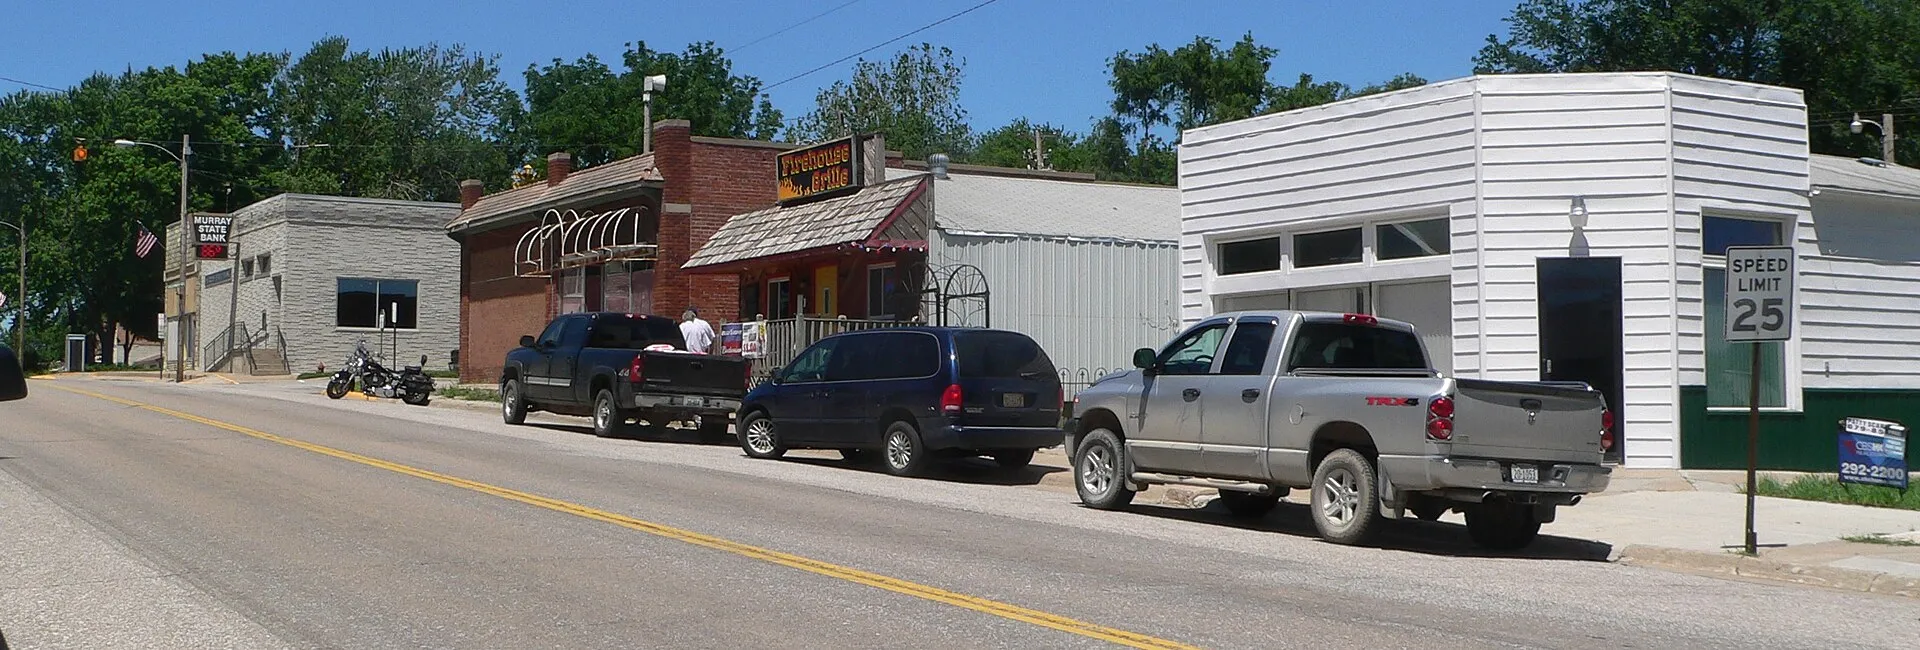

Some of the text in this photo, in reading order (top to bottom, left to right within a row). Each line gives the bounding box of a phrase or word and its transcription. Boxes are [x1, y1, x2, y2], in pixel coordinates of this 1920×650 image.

[781, 144, 849, 177] Firehouse
[812, 166, 849, 193] Grille
[194, 216, 232, 225] MURRAY
[198, 225, 227, 233] STATE
[200, 233, 226, 242] BANK
[1733, 259, 1788, 272] SPEED
[1738, 278, 1781, 291] LIMIT
[1732, 298, 1784, 331] 25
[1841, 462, 1904, 480] 292-2200
